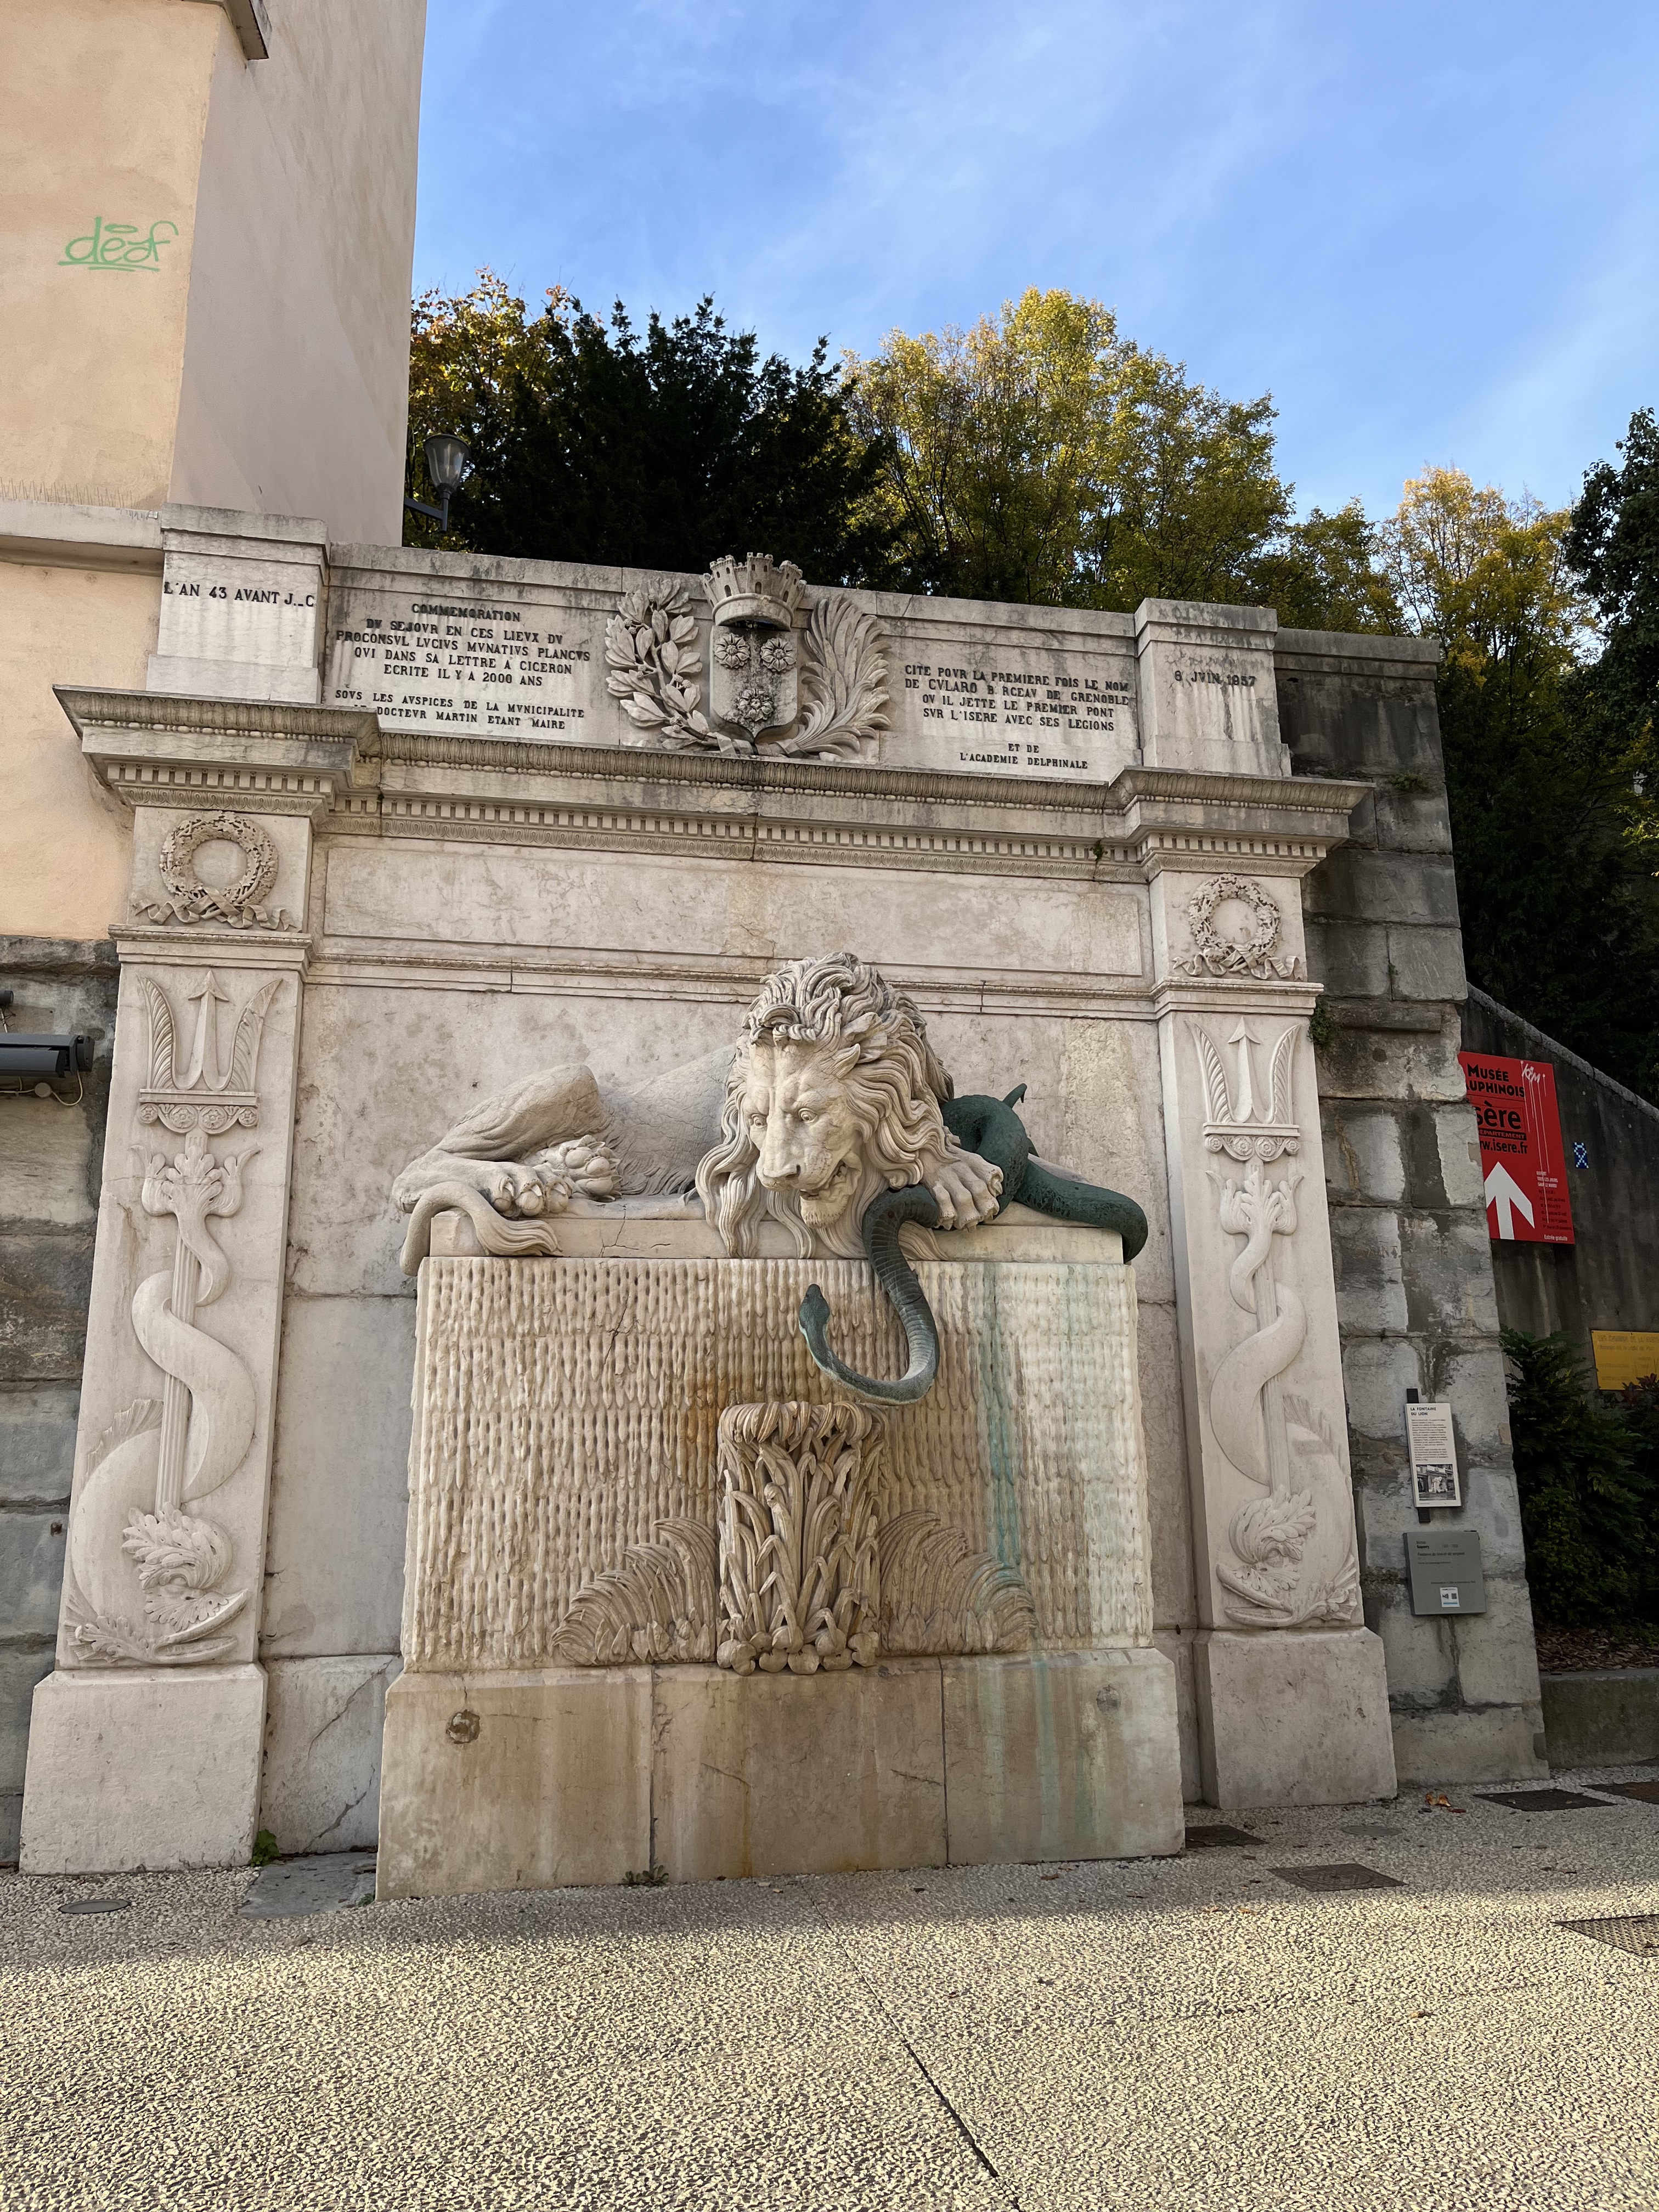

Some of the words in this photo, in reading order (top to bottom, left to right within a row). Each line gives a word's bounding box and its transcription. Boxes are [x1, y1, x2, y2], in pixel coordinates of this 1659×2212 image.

[164, 582, 200, 597] L'AN
[208, 586, 227, 599] 43
[234, 589, 280, 604] AVANT
[412, 603, 521, 622] COMMEMORATION
[366, 618, 382, 629] DV
[391, 620, 438, 634] SEJOVR
[446, 625, 462, 636] EN
[471, 627, 493, 639] CES
[504, 630, 539, 643] LIEVX
[548, 634, 563, 645] DV
[335, 630, 410, 646] PROCONSVL
[416, 637, 458, 650] LVCIVS
[467, 641, 528, 656] MVNATIVS
[538, 647, 591, 661] PLANCVS
[354, 647, 376, 658] QVI
[385, 649, 416, 662] DANS
[426, 653, 439, 664] SA
[448, 654, 496, 669] LETTRE
[504, 659, 511, 670] A
[520, 661, 572, 674] CICERON
[384, 664, 429, 678] ECRITE
[438, 668, 450, 679] IL
[455, 669, 462, 680] Y
[468, 671, 475, 681] A
[482, 672, 512, 684] 2000
[520, 675, 543, 686] ANS
[905, 664, 931, 676] CITE
[938, 667, 967, 679] POVR
[973, 670, 986, 681] LA
[991, 672, 1049, 686] PREMIERE
[1055, 676, 1079, 688] FOIS
[1085, 679, 1098, 689] LE
[1105, 681, 1128, 692] NOM
[1190, 671, 1221, 684] JVIN
[905, 678, 919, 689] DE
[928, 679, 978, 693] CVLARO
[987, 684, 1037, 698] BRCEAV
[1046, 690, 1060, 700] DE
[1071, 692, 1129, 706] GRENOBLE
[335, 690, 363, 701] SOVS
[373, 692, 393, 703] LES
[402, 695, 454, 708] AVSPICES
[463, 699, 477, 709] DE
[486, 702, 499, 712] LA
[507, 703, 584, 718] MVNICIPALITE
[922, 694, 935, 704] OV
[942, 695, 953, 706] IL
[960, 697, 996, 709] JETTE
[1003, 700, 1018, 710] LE
[1026, 702, 1077, 715] PREMIER
[1086, 706, 1114, 718] PONT
[377, 706, 427, 719] DOCTEVR
[436, 710, 477, 723] MARTIN
[488, 715, 521, 726] ETANT
[532, 719, 566, 730] MAIRE
[923, 708, 944, 719] SVR
[951, 709, 997, 723] L'ISERE
[1005, 714, 1032, 725] AVEC
[1040, 716, 1059, 727] SES
[1068, 718, 1114, 731] LEGIONS
[1008, 743, 1020, 752] ET
[1026, 744, 1039, 753] DE
[960, 752, 1018, 764] L'ACADEMIE
[1027, 757, 1088, 769] DELPHINALE
[1467, 1063, 1509, 1082] MUSÉE
[1475, 1100, 1522, 1130] sère
[1480, 1129, 1526, 1139] ÉPARTEMENT
